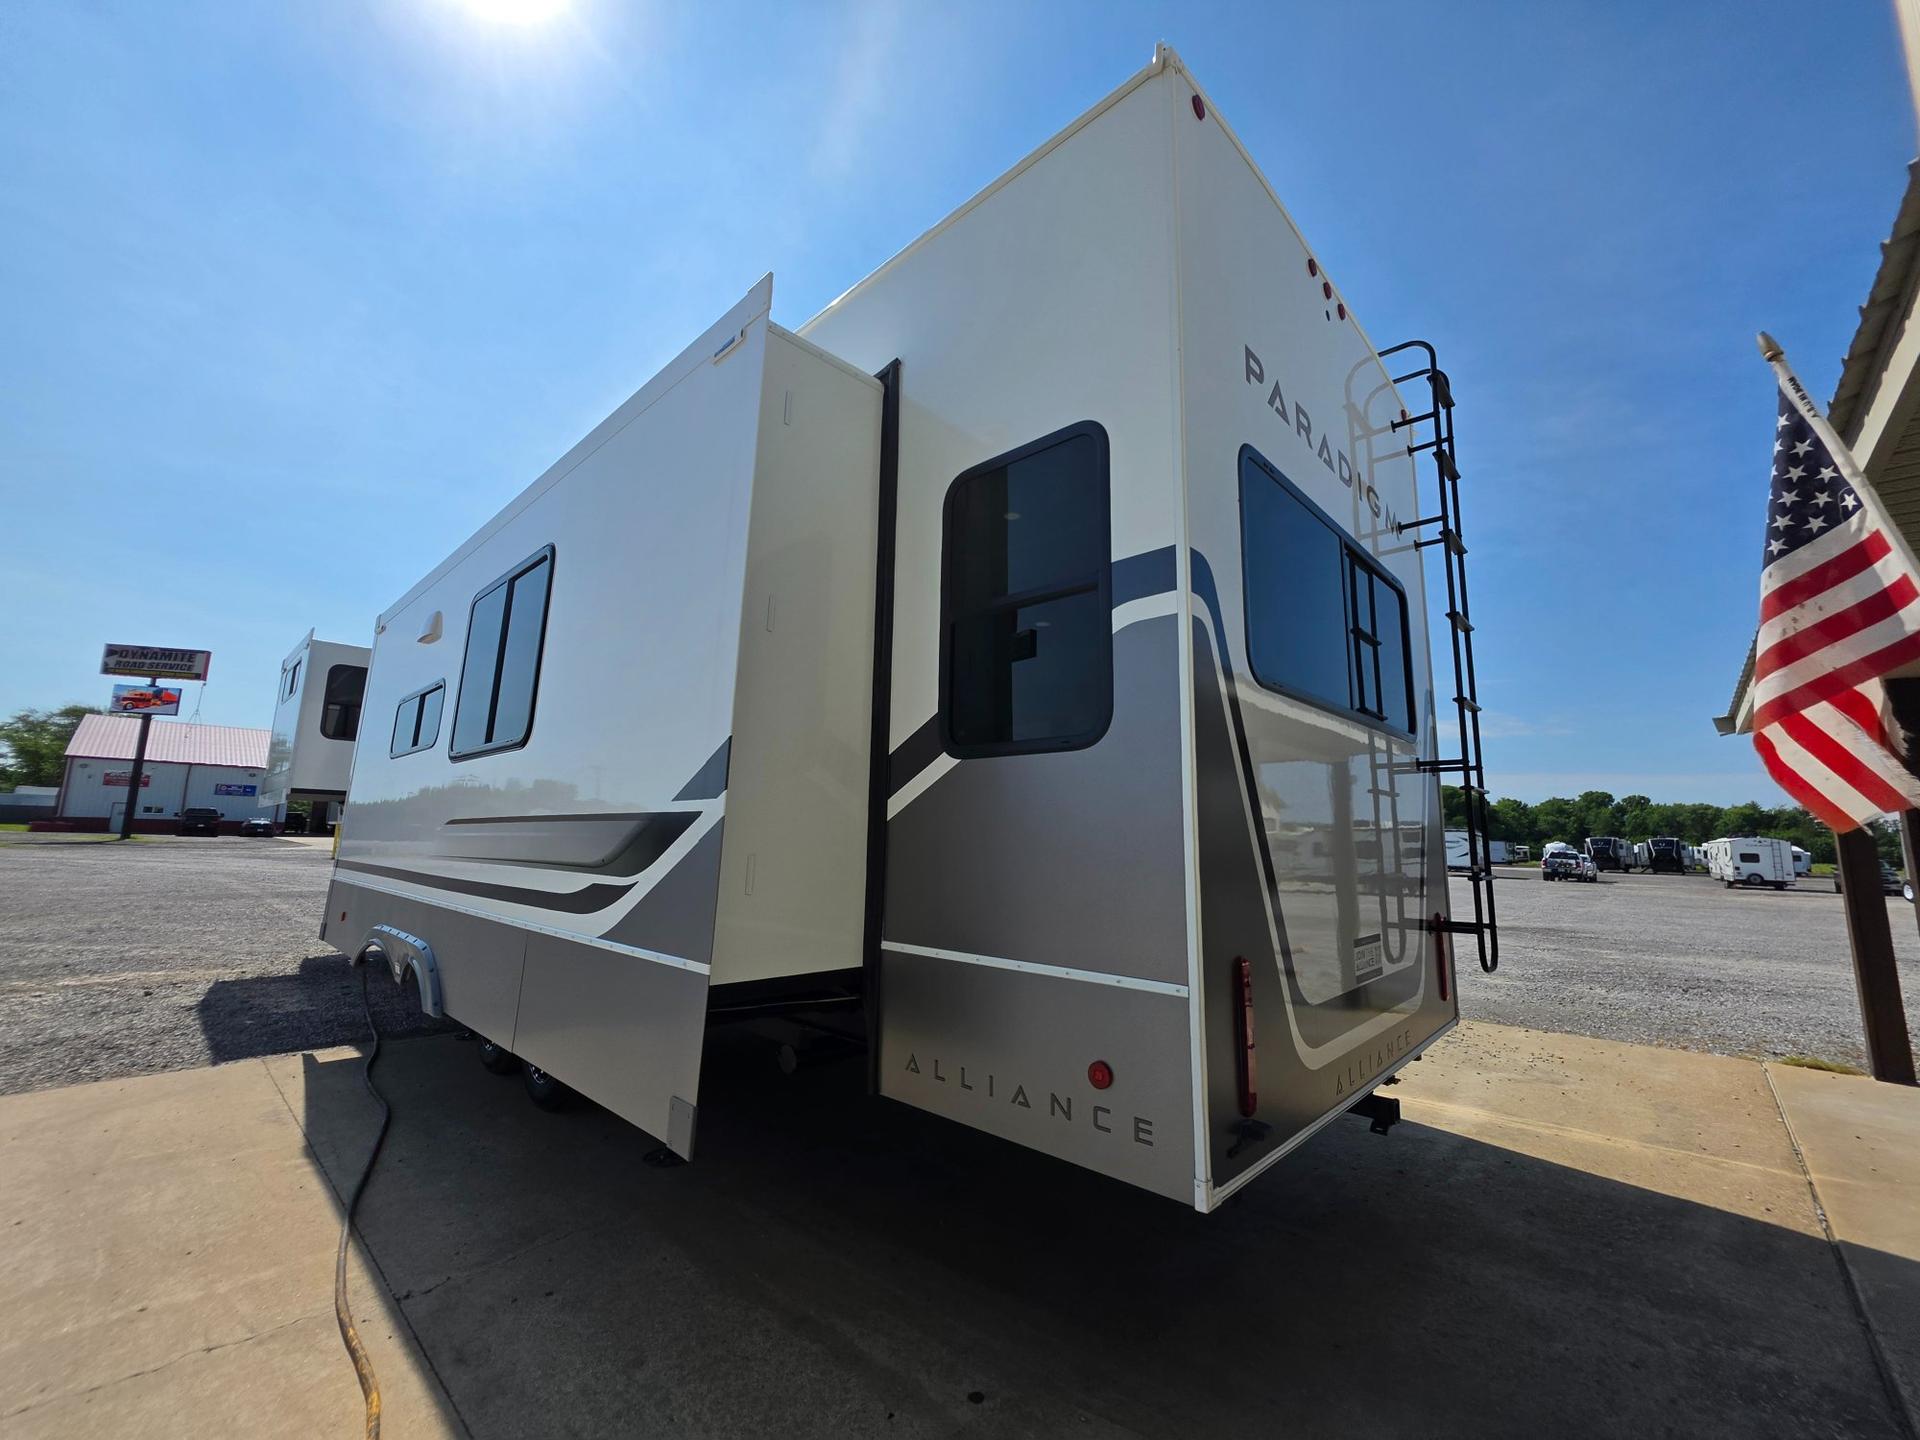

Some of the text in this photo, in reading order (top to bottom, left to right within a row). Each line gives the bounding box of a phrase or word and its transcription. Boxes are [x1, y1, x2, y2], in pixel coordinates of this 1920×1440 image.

[1245, 344, 1400, 541] PARADIGM
[114, 660, 194, 671] ROAD SERVICE
[118, 650, 195, 663] DYNAMITE
[1336, 1029, 1413, 1096] ALLIANCE
[905, 1053, 1154, 1147] ALLIANCE
